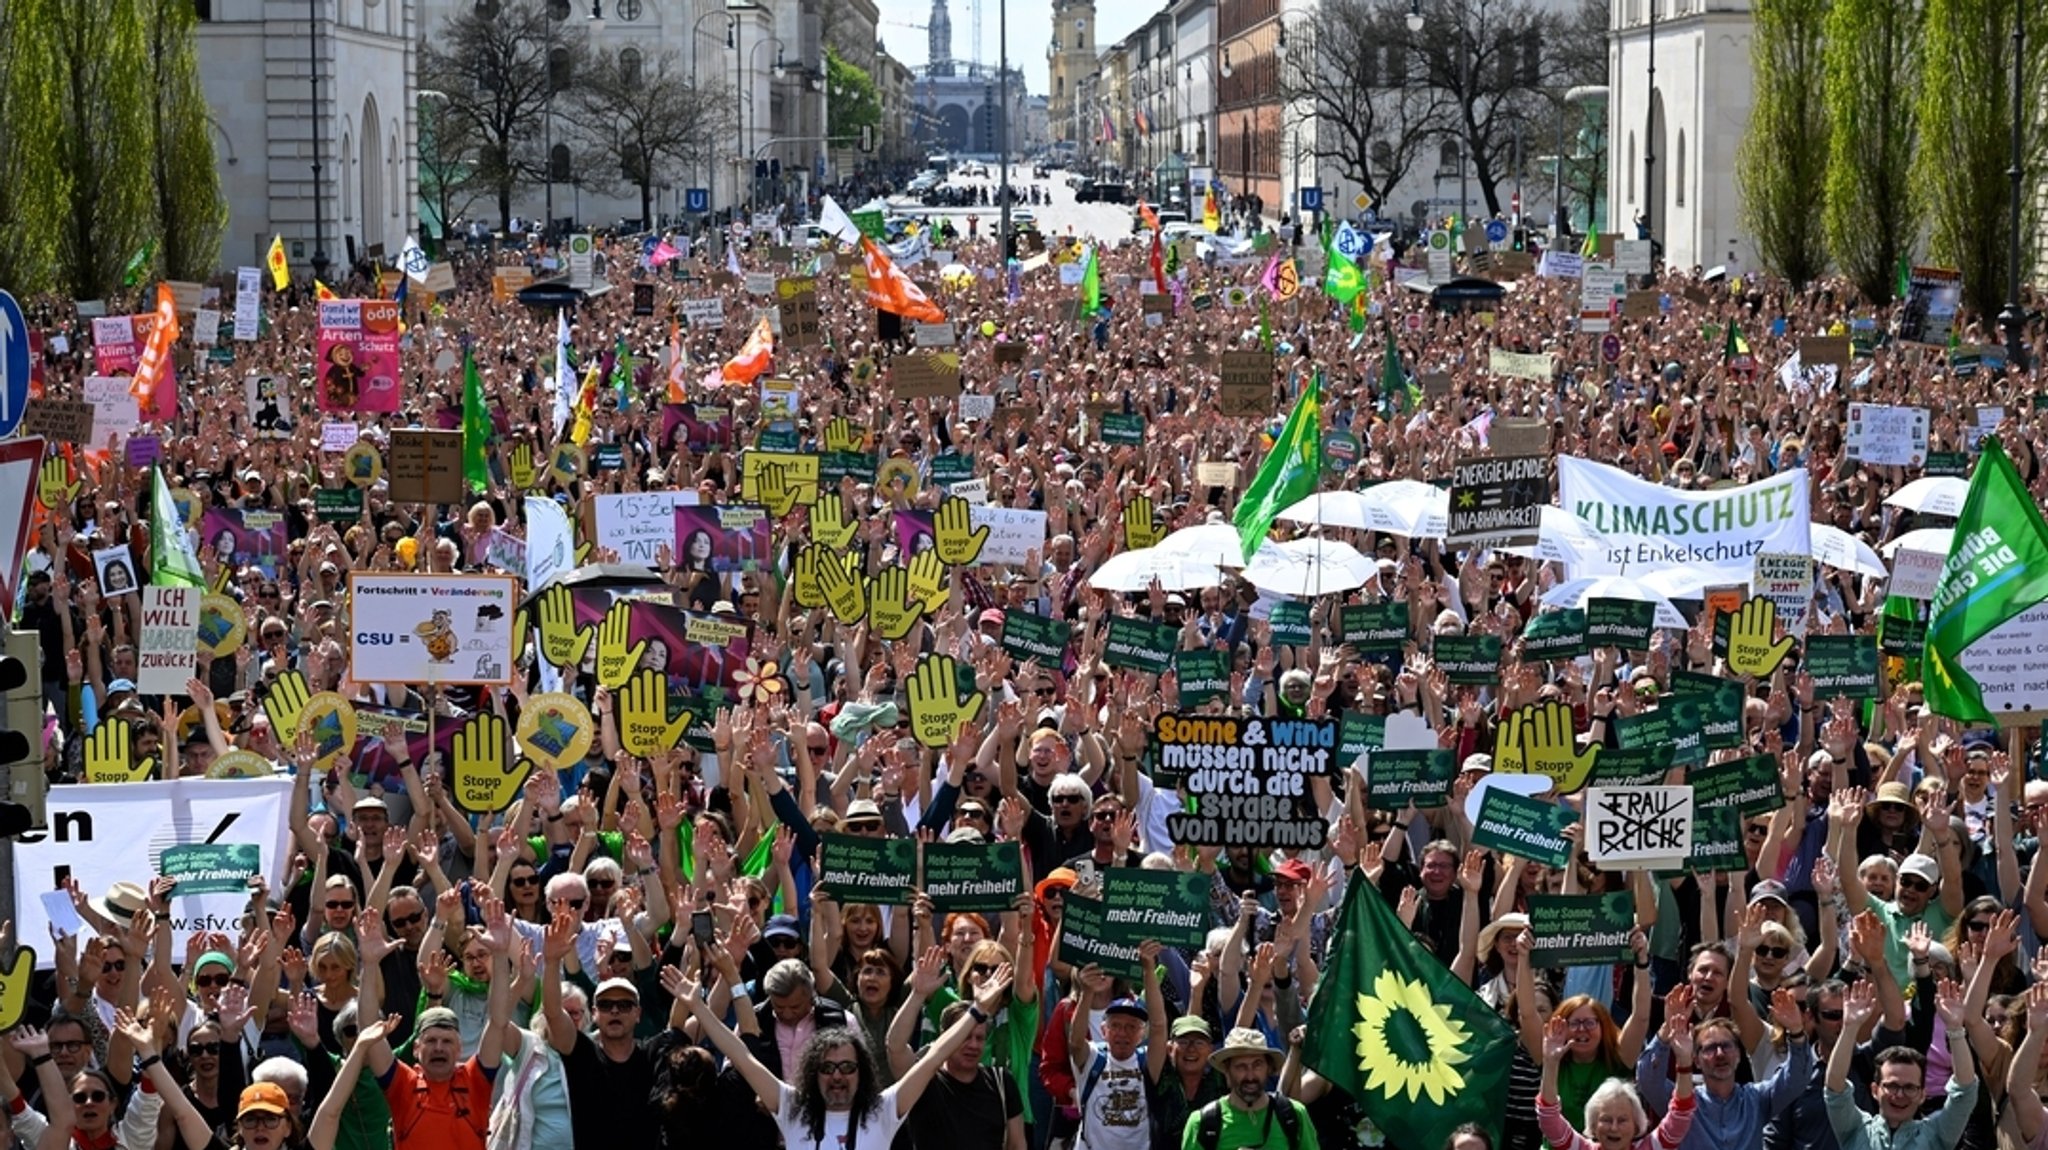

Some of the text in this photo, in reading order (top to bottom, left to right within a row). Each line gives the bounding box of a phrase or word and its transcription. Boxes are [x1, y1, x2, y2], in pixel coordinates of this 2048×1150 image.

[690, 192, 702, 209] U
[1306, 190, 1318, 206] U
[366, 306, 396, 321] ödp
[322, 330, 362, 341] Arten
[99, 346, 135, 357] Klima
[359, 341, 394, 352] Schutz
[754, 459, 800, 474] Znft
[954, 484, 981, 494] OMAS
[1576, 484, 1795, 537] KLIMASCHUTZ
[943, 537, 970, 548] Stopp
[945, 547, 966, 557] Gas!
[1607, 540, 1764, 564] ist Enkelschutz
[1761, 568, 1806, 579] WENDE
[356, 585, 418, 596] Fortschritt
[431, 586, 504, 599] Veränderung
[1770, 583, 1800, 593] STATT
[157, 588, 186, 607] ICH
[835, 590, 856, 608] Stopp
[145, 609, 191, 627] WILL
[689, 619, 711, 630] Frau
[876, 611, 903, 623] Stopp
[1287, 622, 1312, 635] Freih
[1344, 626, 1406, 642] mehr Freiheit!
[1588, 623, 1648, 638] mehr Freiheit!
[2009, 630, 2032, 640] weiter
[356, 633, 394, 646] CSU
[548, 634, 576, 647] Stopp
[1004, 633, 1062, 657] mehr Freiheit!
[1527, 633, 1584, 651] mehr Freiheit!
[1107, 641, 1169, 663] mehr Freiheit!
[1736, 644, 1770, 656] Stopp
[1997, 646, 2022, 657] Kohle
[2023, 646, 2032, 655] &
[142, 651, 194, 669] ZURÜCK!
[603, 656, 626, 668] Stopp
[1436, 661, 1497, 672] mehr Freiheit!
[1737, 656, 1762, 667] Gas!
[1966, 662, 1985, 673] und
[1988, 662, 2017, 674] Kriege
[1206, 678, 1229, 691] Freih
[1811, 674, 1875, 688] mehr Freiheit!
[1978, 682, 2016, 694] Denkt
[920, 711, 958, 726] Stopp
[405, 721, 427, 732] dem
[630, 723, 667, 737] Stopp
[924, 725, 951, 738] Gas!
[1158, 716, 1335, 748] Sonne & Wind
[1703, 720, 1738, 737] eiheit!
[632, 736, 659, 748] Gas!
[1162, 744, 1329, 774] müssen nicht
[1534, 760, 1574, 773] Stopp
[95, 771, 130, 784] Stopp
[463, 775, 501, 790] Stopp
[1188, 768, 1304, 797] durch die
[1552, 772, 1567, 785] as!
[1372, 779, 1448, 794] mehr Freiheit!
[466, 790, 495, 803] Gas!
[1728, 784, 1776, 806] Freiheit!
[1604, 791, 1669, 817] FRAU
[1170, 817, 1323, 847] von Hormus
[1480, 818, 1566, 852] mehr Freiheit!
[1599, 817, 1686, 853] REICHE
[1693, 842, 1739, 858] Freiheit!
[173, 868, 253, 882] ehr Freiheit!
[823, 870, 911, 888] mehr Freiheit!
[927, 878, 1017, 897] mehr Freiheit!
[1108, 879, 1171, 897] Mehr Sonne,
[1107, 893, 1165, 909] mehr Wind,
[1106, 908, 1202, 928] mehr Freiheit!
[1534, 904, 1597, 920] Mehr Sonne,
[1534, 918, 1590, 933] mehr Wind,
[1062, 931, 1141, 963] mehr Freiheit!
[1535, 931, 1631, 950] mehr Freiheit!
